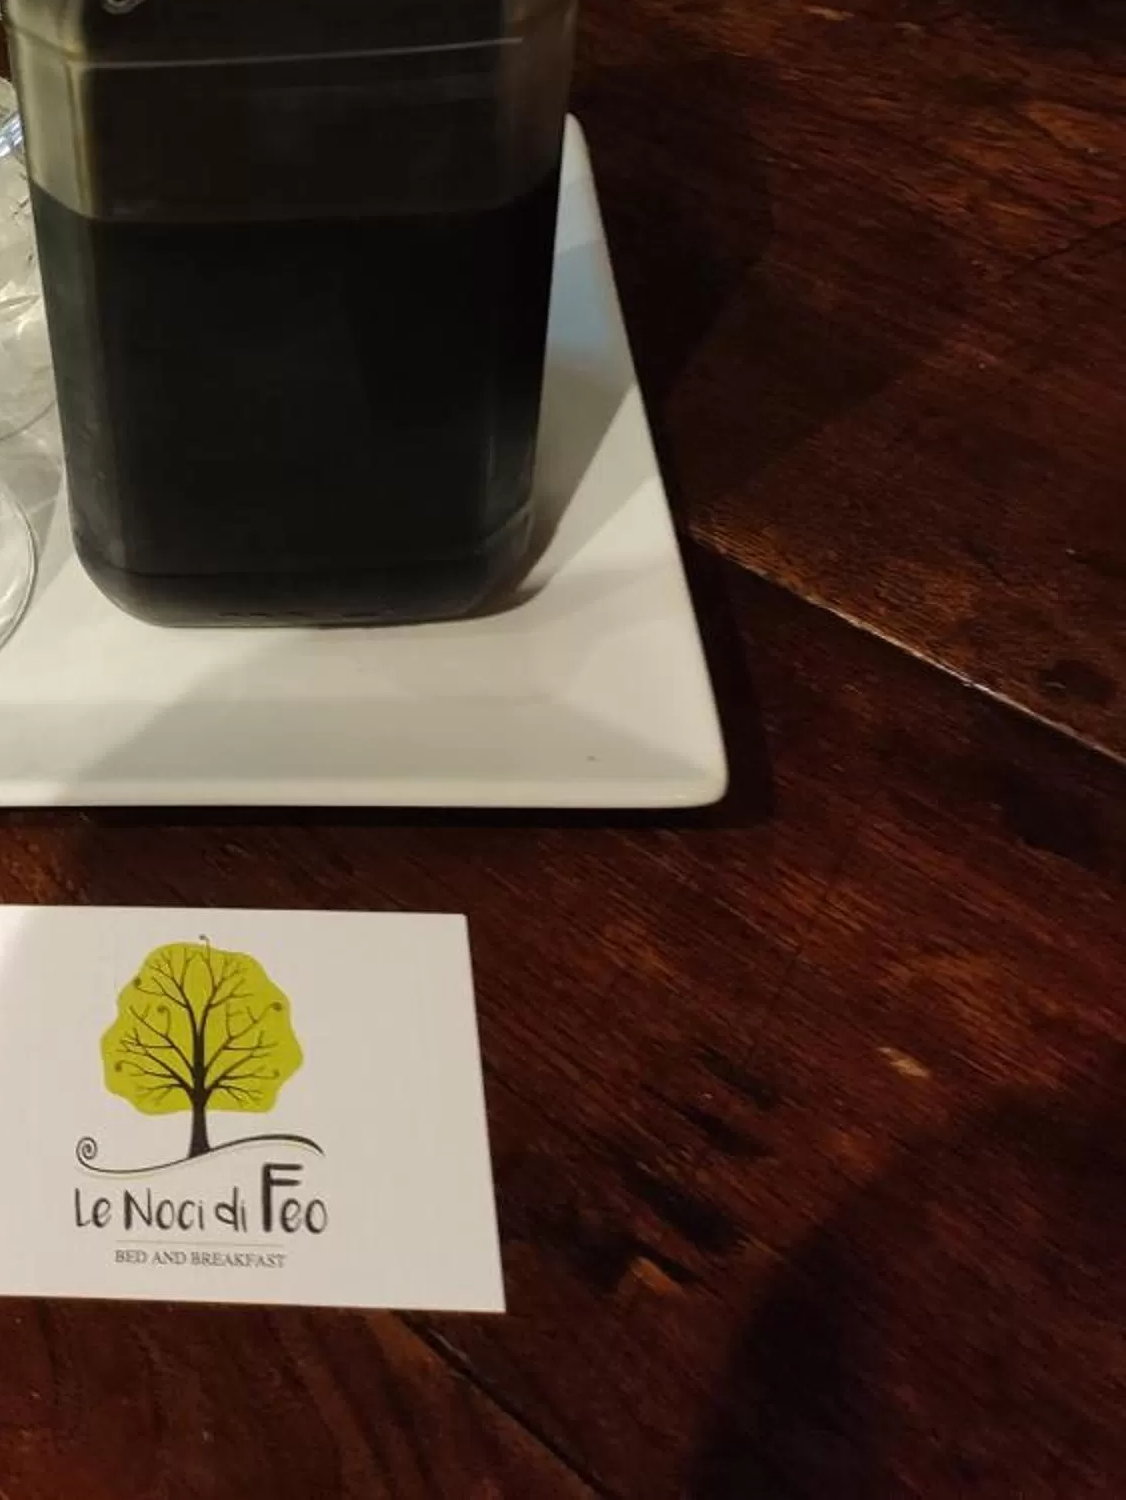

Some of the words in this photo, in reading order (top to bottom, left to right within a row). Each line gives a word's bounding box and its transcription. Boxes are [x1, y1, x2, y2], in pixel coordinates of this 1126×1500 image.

[75, 1187, 113, 1229] Le
[122, 1187, 206, 1231] Noci
[215, 1185, 248, 1233] di
[261, 1162, 329, 1235] Feo
[115, 1249, 148, 1264] BED
[152, 1250, 187, 1266] AND
[190, 1251, 288, 1268] BREAKFAST
